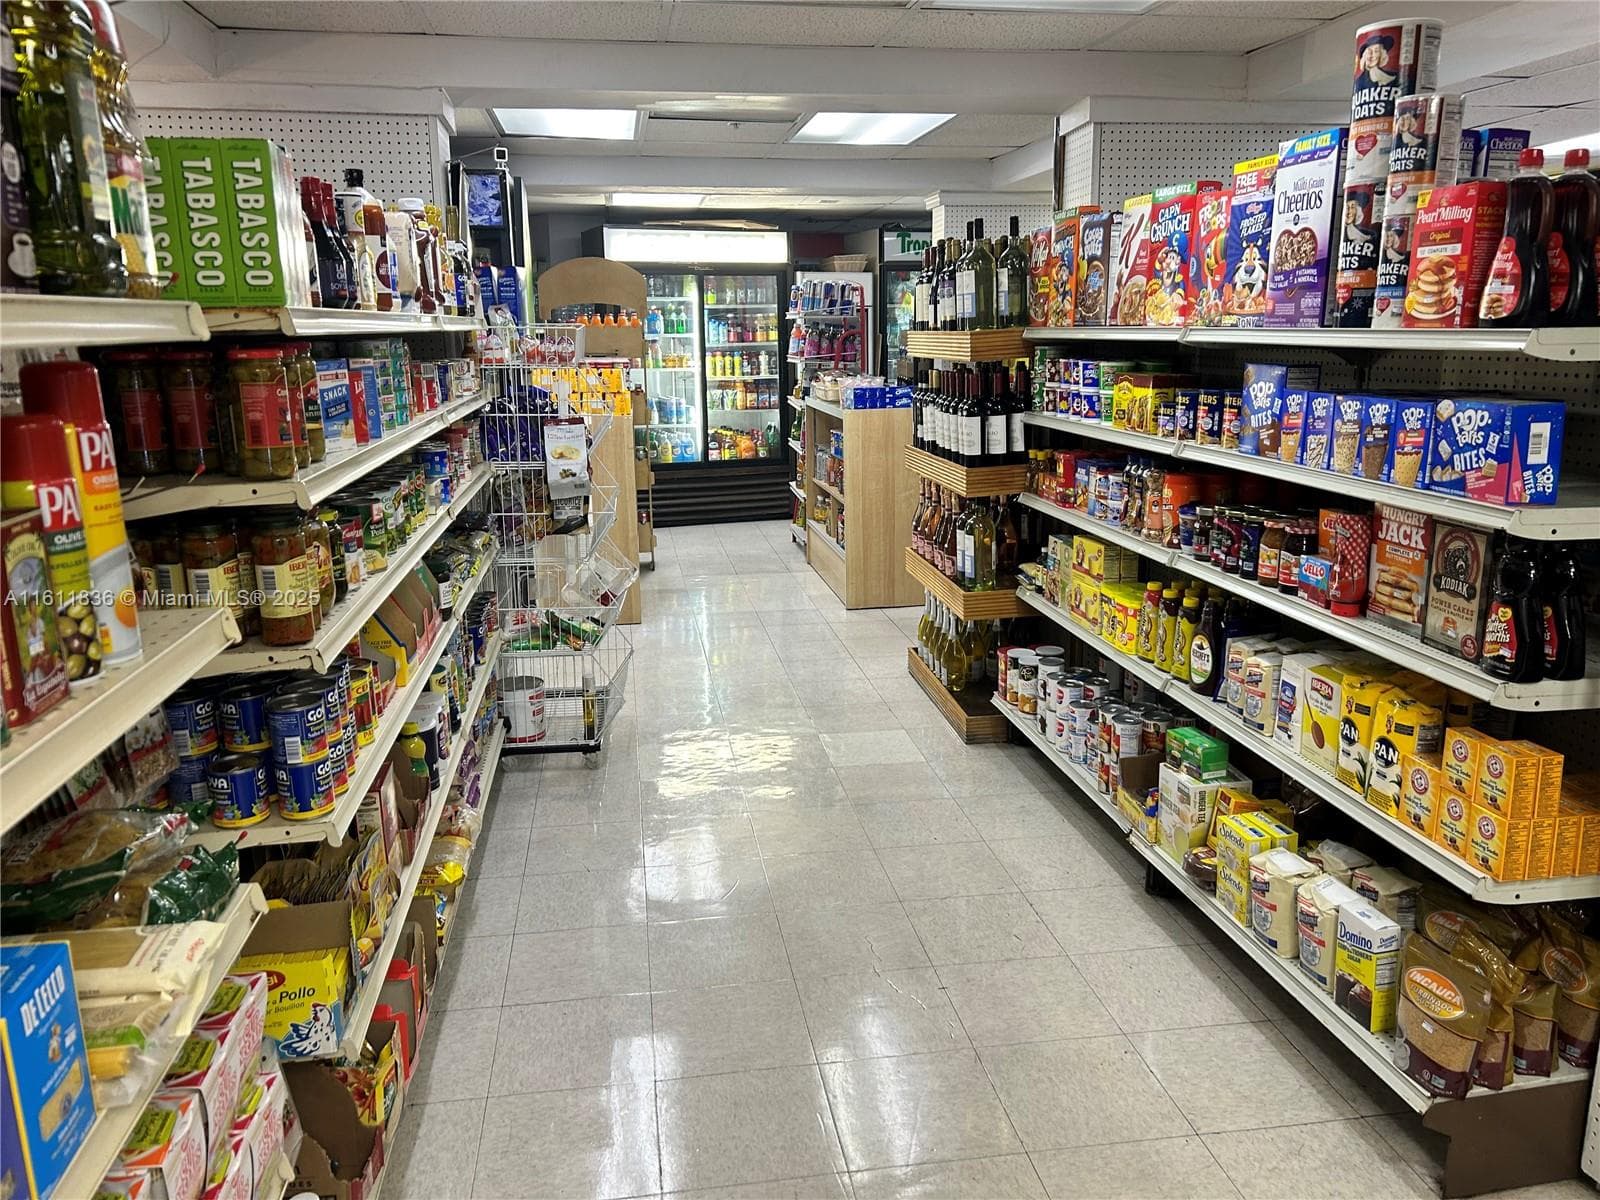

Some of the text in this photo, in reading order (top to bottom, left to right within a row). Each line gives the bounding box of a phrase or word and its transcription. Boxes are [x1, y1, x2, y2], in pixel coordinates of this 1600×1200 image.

[1354, 102, 1385, 118] OATS
[1294, 138, 1315, 153] FAMILY
[1316, 135, 1332, 149] SIZE
[1155, 183, 1192, 198] LARGE SIZE
[1235, 172, 1258, 188] FREE
[1293, 176, 1325, 192] Multi Grain
[1277, 189, 1323, 215] Cheerios
[182, 157, 226, 286] TABASCO
[232, 158, 274, 286] TABASCO
[1240, 212, 1267, 230] FROSTED
[1417, 205, 1473, 225] Pearl Milling
[1150, 213, 1192, 243] CRUNCH
[1240, 223, 1263, 239] FLAKES
[1341, 241, 1374, 257] AKER
[1380, 263, 1409, 276] AKER
[323, 385, 347, 401] SNACK
[1250, 410, 1272, 428] BITES
[1453, 447, 1486, 471] BITES
[1522, 470, 1536, 495] BITES
[1382, 506, 1427, 527] HUNGRY
[1378, 519, 1426, 550] JACK
[1388, 545, 1412, 557] COMPLETE
[1440, 575, 1469, 598] KODIAK
[1431, 595, 1475, 617] POWER CAKES
[1340, 721, 1359, 742] PAN
[1374, 741, 1399, 763] PAN
[1198, 812, 1206, 824] TEA
[1219, 822, 1245, 849] Splenda
[1219, 865, 1243, 893] Splenda
[1431, 912, 1462, 933] INCA
[1339, 921, 1373, 950] Domino
[1346, 953, 1361, 964] SUGAR
[279, 986, 316, 1004] Pollo
[1409, 970, 1461, 1007] INCAUCA
